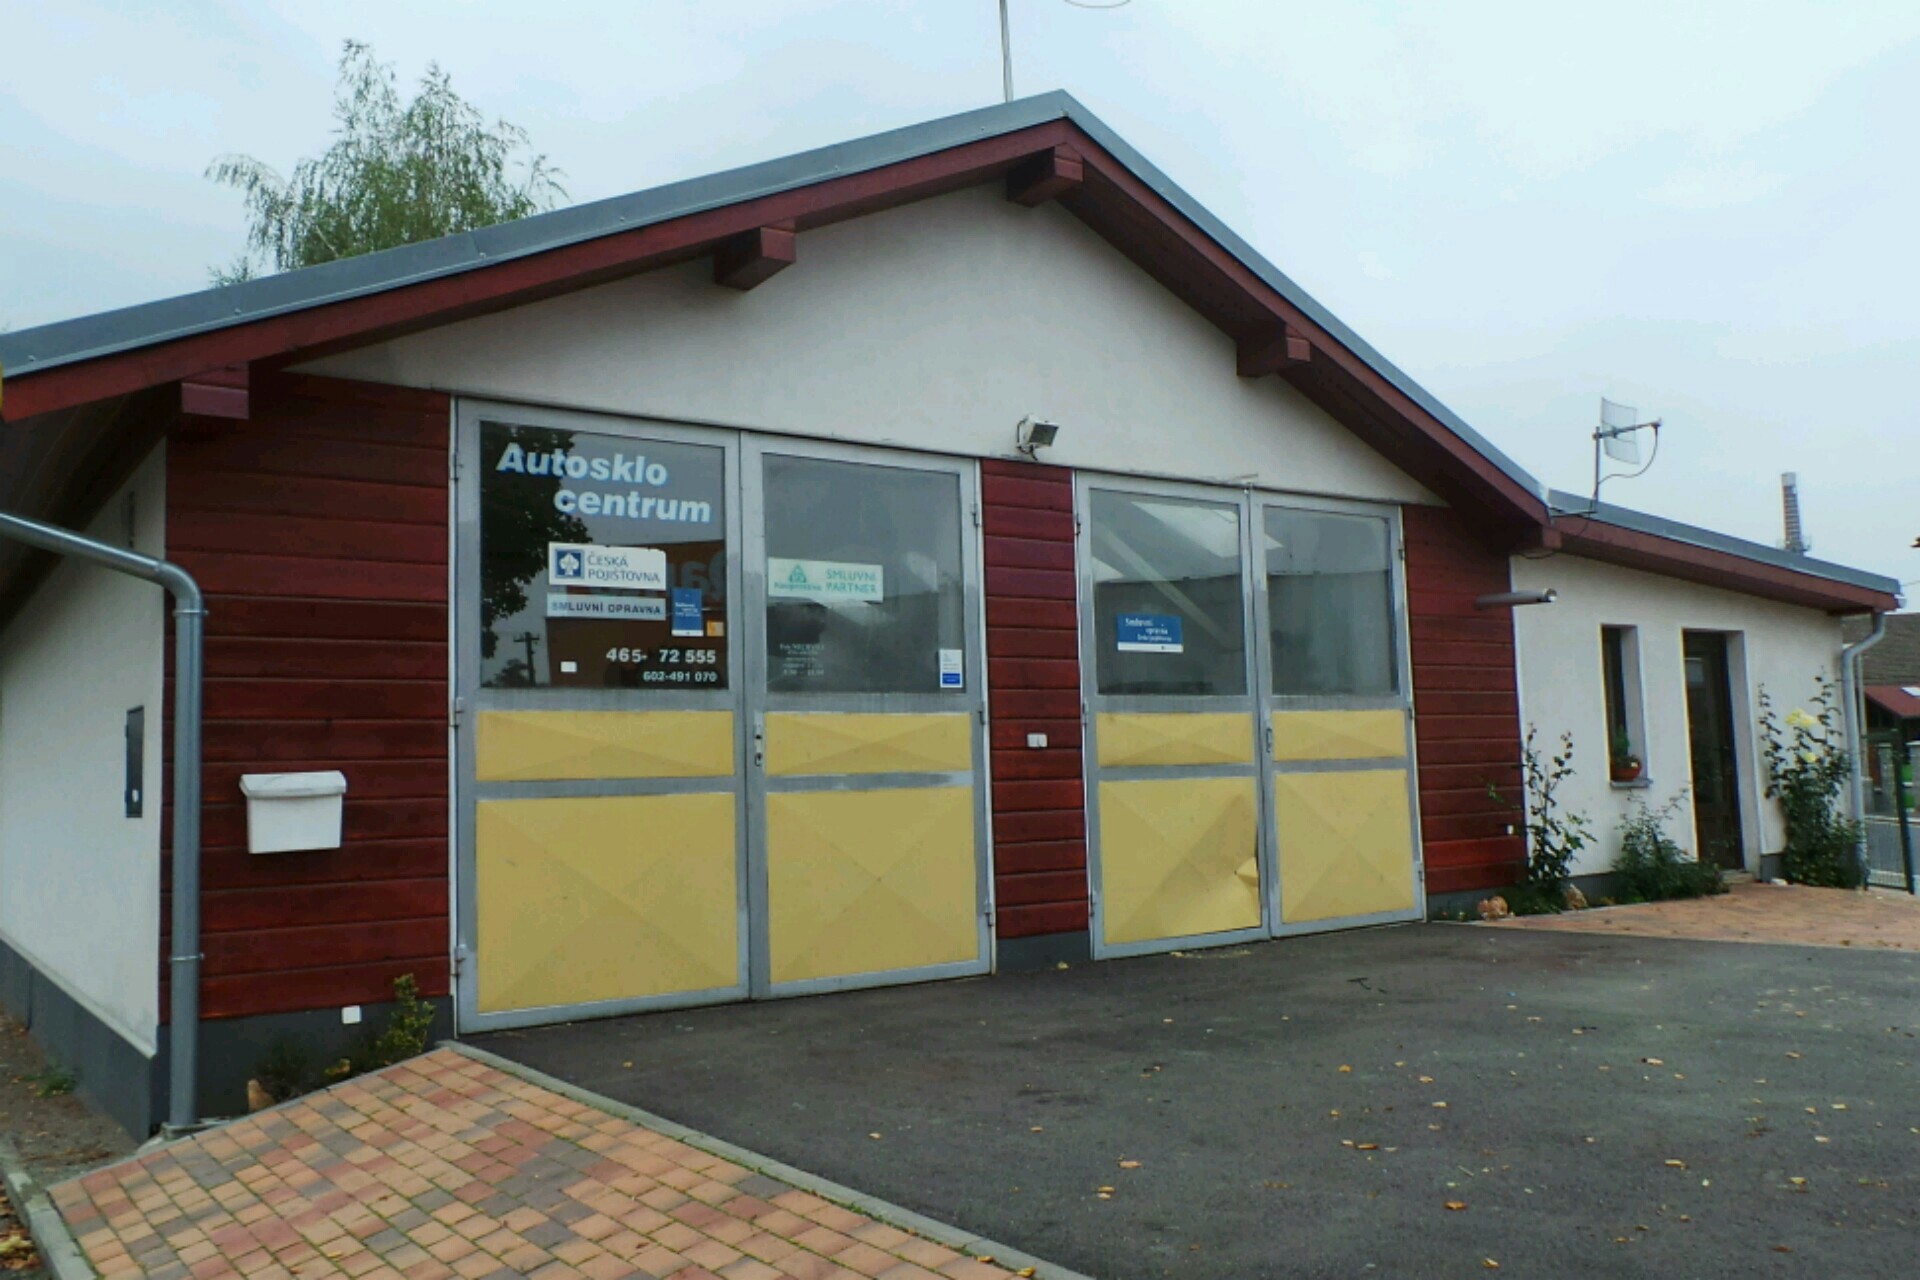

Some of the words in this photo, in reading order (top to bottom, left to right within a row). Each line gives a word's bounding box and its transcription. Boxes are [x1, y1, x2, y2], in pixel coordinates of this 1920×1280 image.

[496, 442, 668, 486] Autosklo
[554, 489, 711, 522] centrum
[587, 551, 629, 567] ČESKÁ
[825, 582, 876, 593] PARTNER
[608, 604, 661, 614] OPRAVNA
[659, 649, 680, 662] 72
[685, 649, 716, 663] 555
[694, 671, 718, 682] 070
